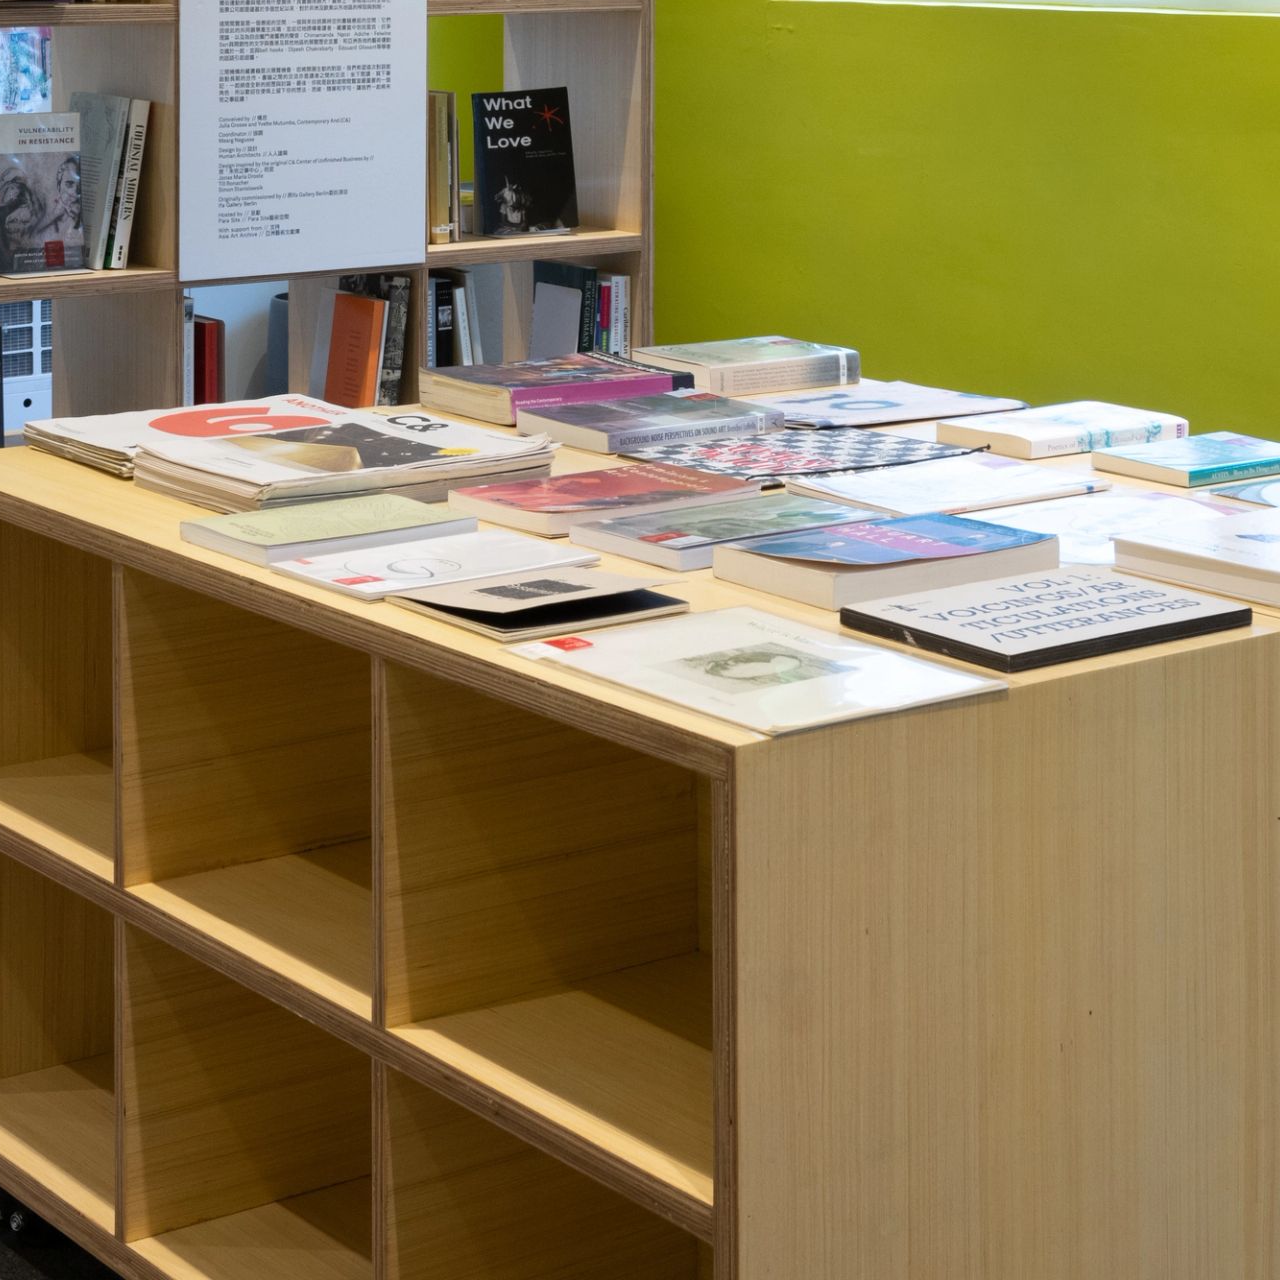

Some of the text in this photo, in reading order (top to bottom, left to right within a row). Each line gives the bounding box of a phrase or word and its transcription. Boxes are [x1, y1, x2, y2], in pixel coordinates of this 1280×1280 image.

[483, 95, 533, 112] What
[18, 126, 74, 135] VULNERABILITY
[485, 116, 514, 130] We
[29, 137, 75, 145] RESISTANCE
[486, 135, 532, 149] Love
[123, 125, 144, 221] COLONIAL MODERN
[582, 280, 592, 348] BLACK GERMANY
[283, 397, 347, 416] ANOTHER
[385, 415, 448, 434] C&
[620, 425, 727, 446] BACKGROUND NOISE PERSPECTIVES ON SOUND ART
[999, 577, 1067, 593] VOL
[920, 580, 1136, 621] VOICINGS/AR
[959, 589, 1168, 631] TICULATIONS
[990, 598, 1202, 642] /UTTERANCES
